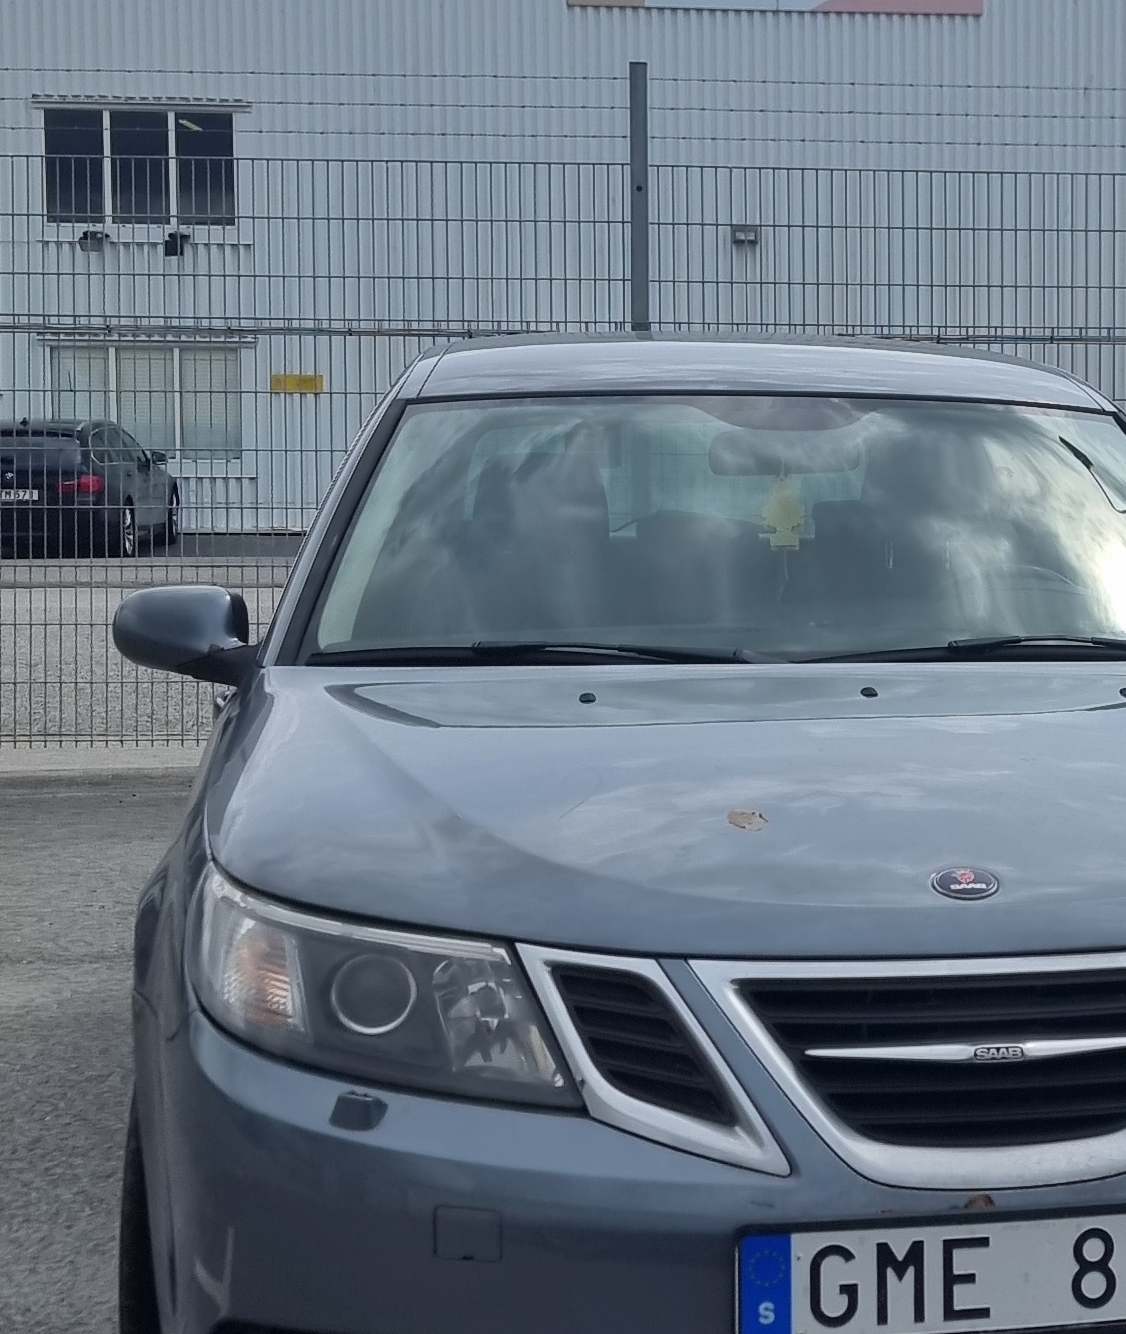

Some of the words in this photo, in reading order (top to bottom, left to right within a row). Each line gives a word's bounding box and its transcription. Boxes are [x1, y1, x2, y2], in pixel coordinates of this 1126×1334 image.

[975, 1047, 1022, 1060] SAAB
[809, 1236, 991, 1327] GME
[758, 1302, 775, 1324] S
